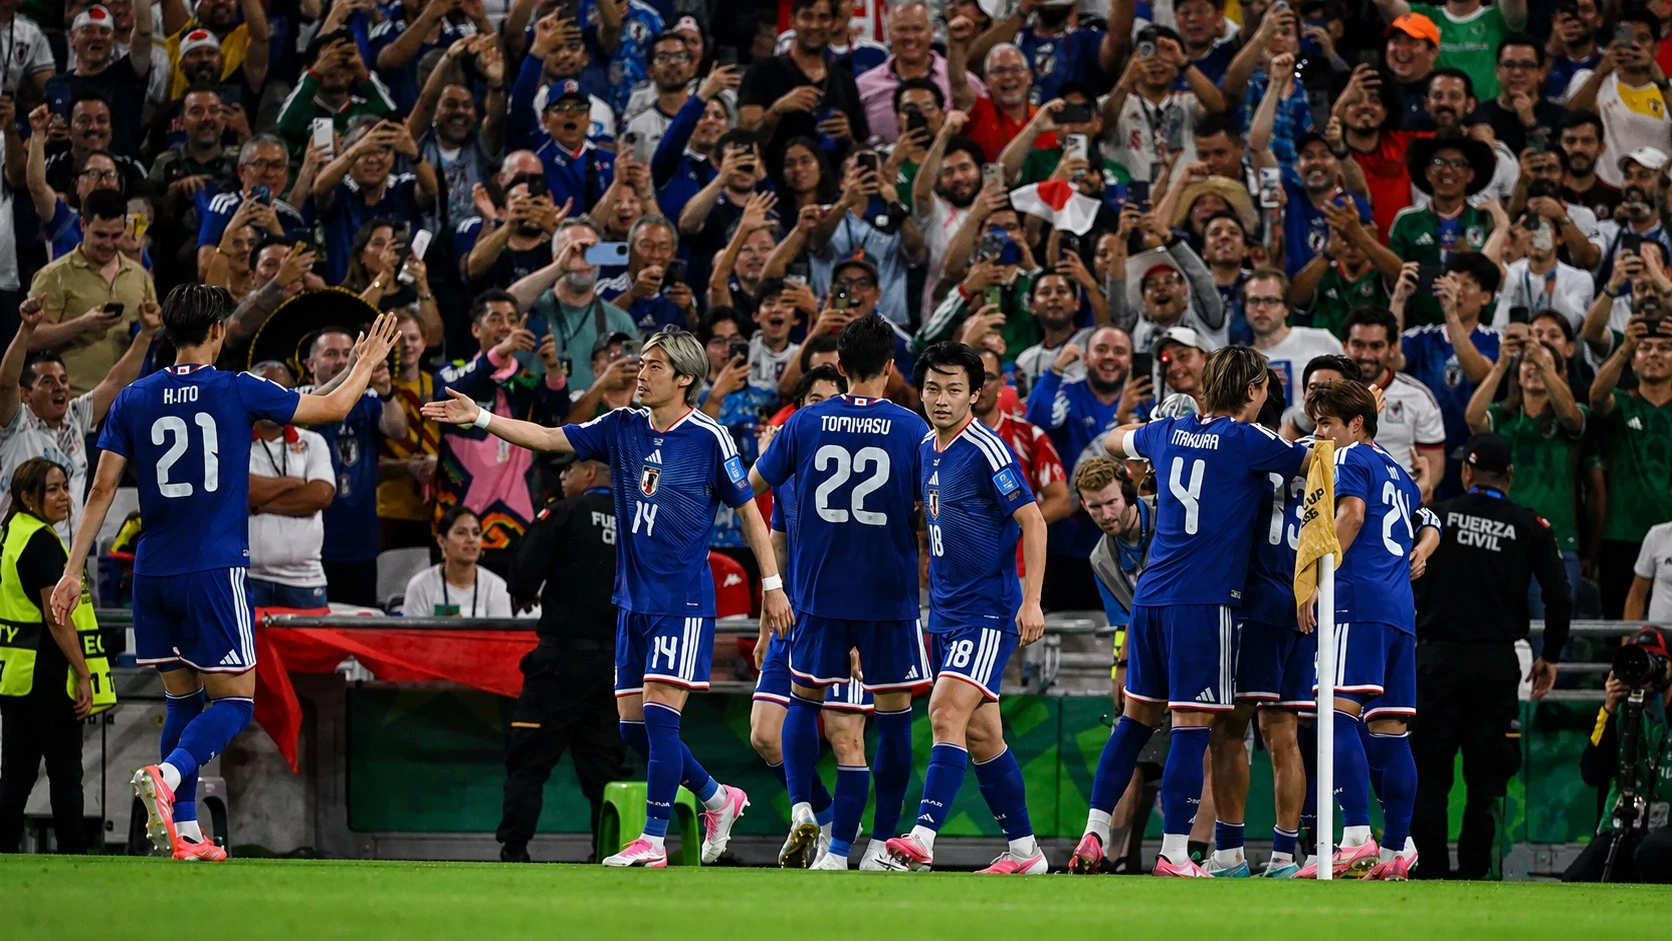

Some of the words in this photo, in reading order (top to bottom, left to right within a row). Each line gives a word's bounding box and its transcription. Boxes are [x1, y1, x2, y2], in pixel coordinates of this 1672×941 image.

[163, 385, 199, 404] H.ITO
[821, 415, 892, 435] TOMIYASU
[1171, 429, 1220, 450] ITAKURA
[151, 412, 219, 498] 21
[814, 444, 891, 526] 22
[1169, 456, 1206, 535] 4
[631, 500, 659, 537] 14
[1446, 511, 1517, 541] FUERZA
[929, 524, 945, 557] 18
[1456, 529, 1502, 553] CIVIL
[651, 635, 678, 670] 14
[944, 639, 974, 668] 18
